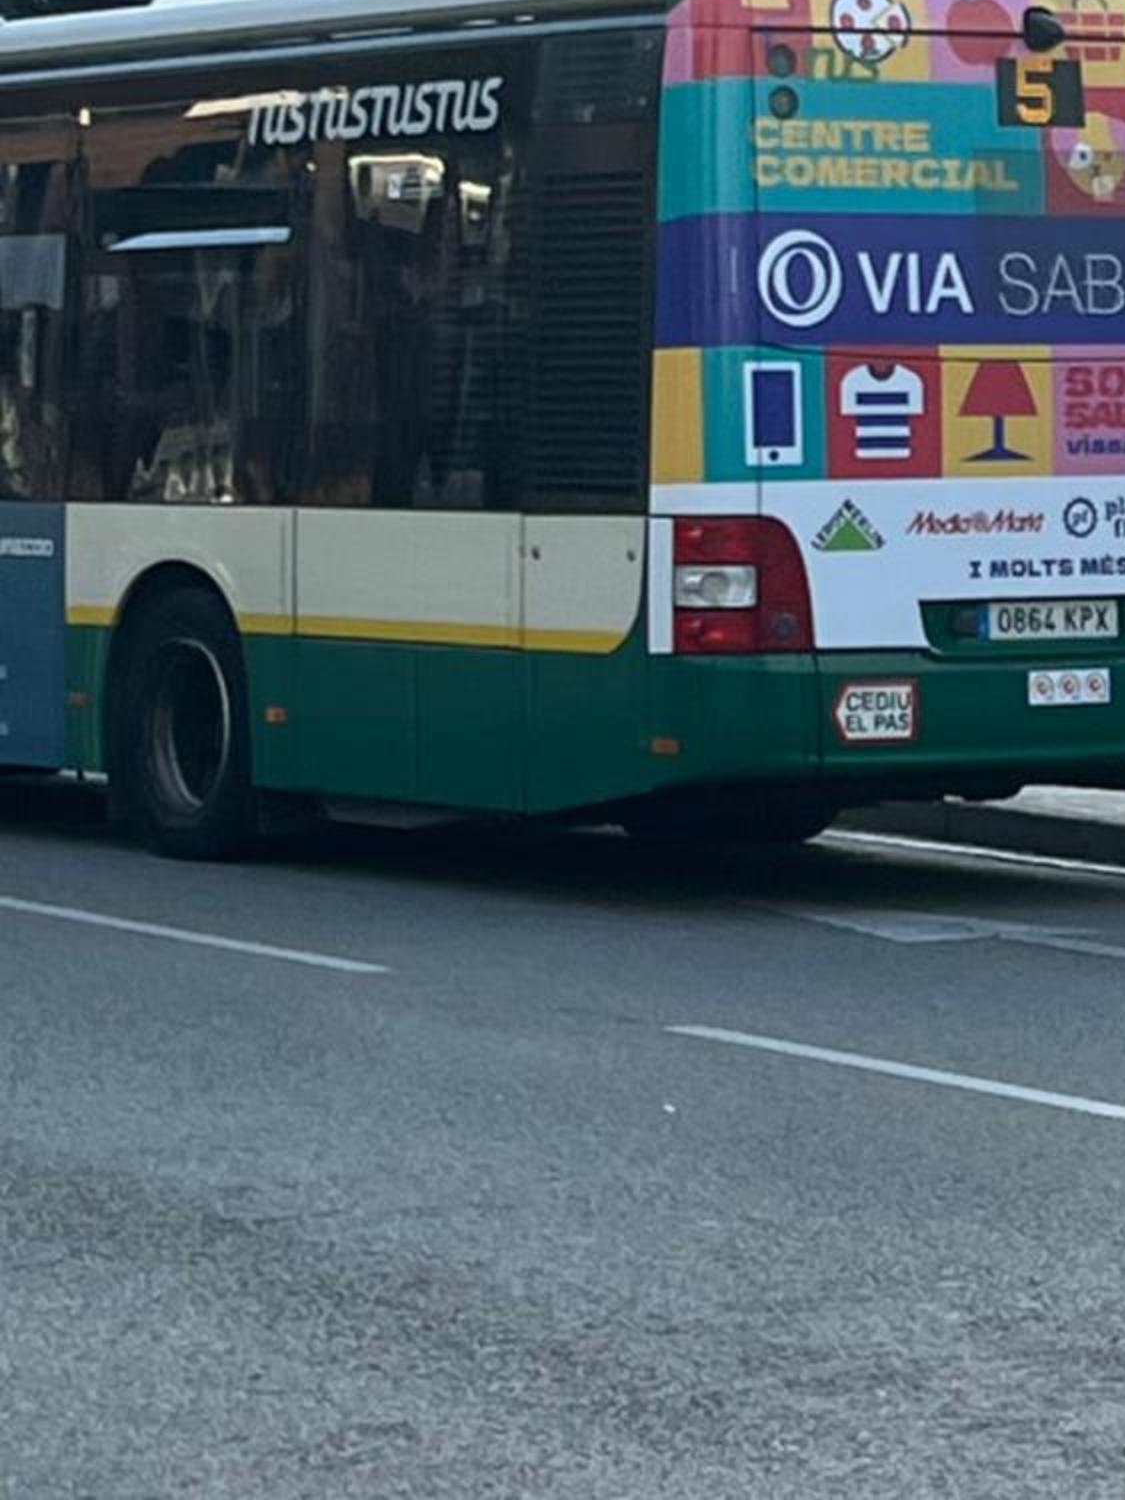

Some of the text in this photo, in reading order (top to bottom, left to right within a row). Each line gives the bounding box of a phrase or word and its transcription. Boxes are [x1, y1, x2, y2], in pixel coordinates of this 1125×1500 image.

[1016, 56, 1054, 125] 5
[755, 116, 931, 152] CENTRE
[756, 153, 1019, 191] COMERCIAL
[856, 252, 975, 314] VIA
[969, 561, 982, 579] I
[990, 559, 1074, 578] MOLTS
[997, 605, 1110, 634] 0864 KPX
[846, 691, 911, 712] CEDIU
[846, 712, 910, 732] EL PAS
